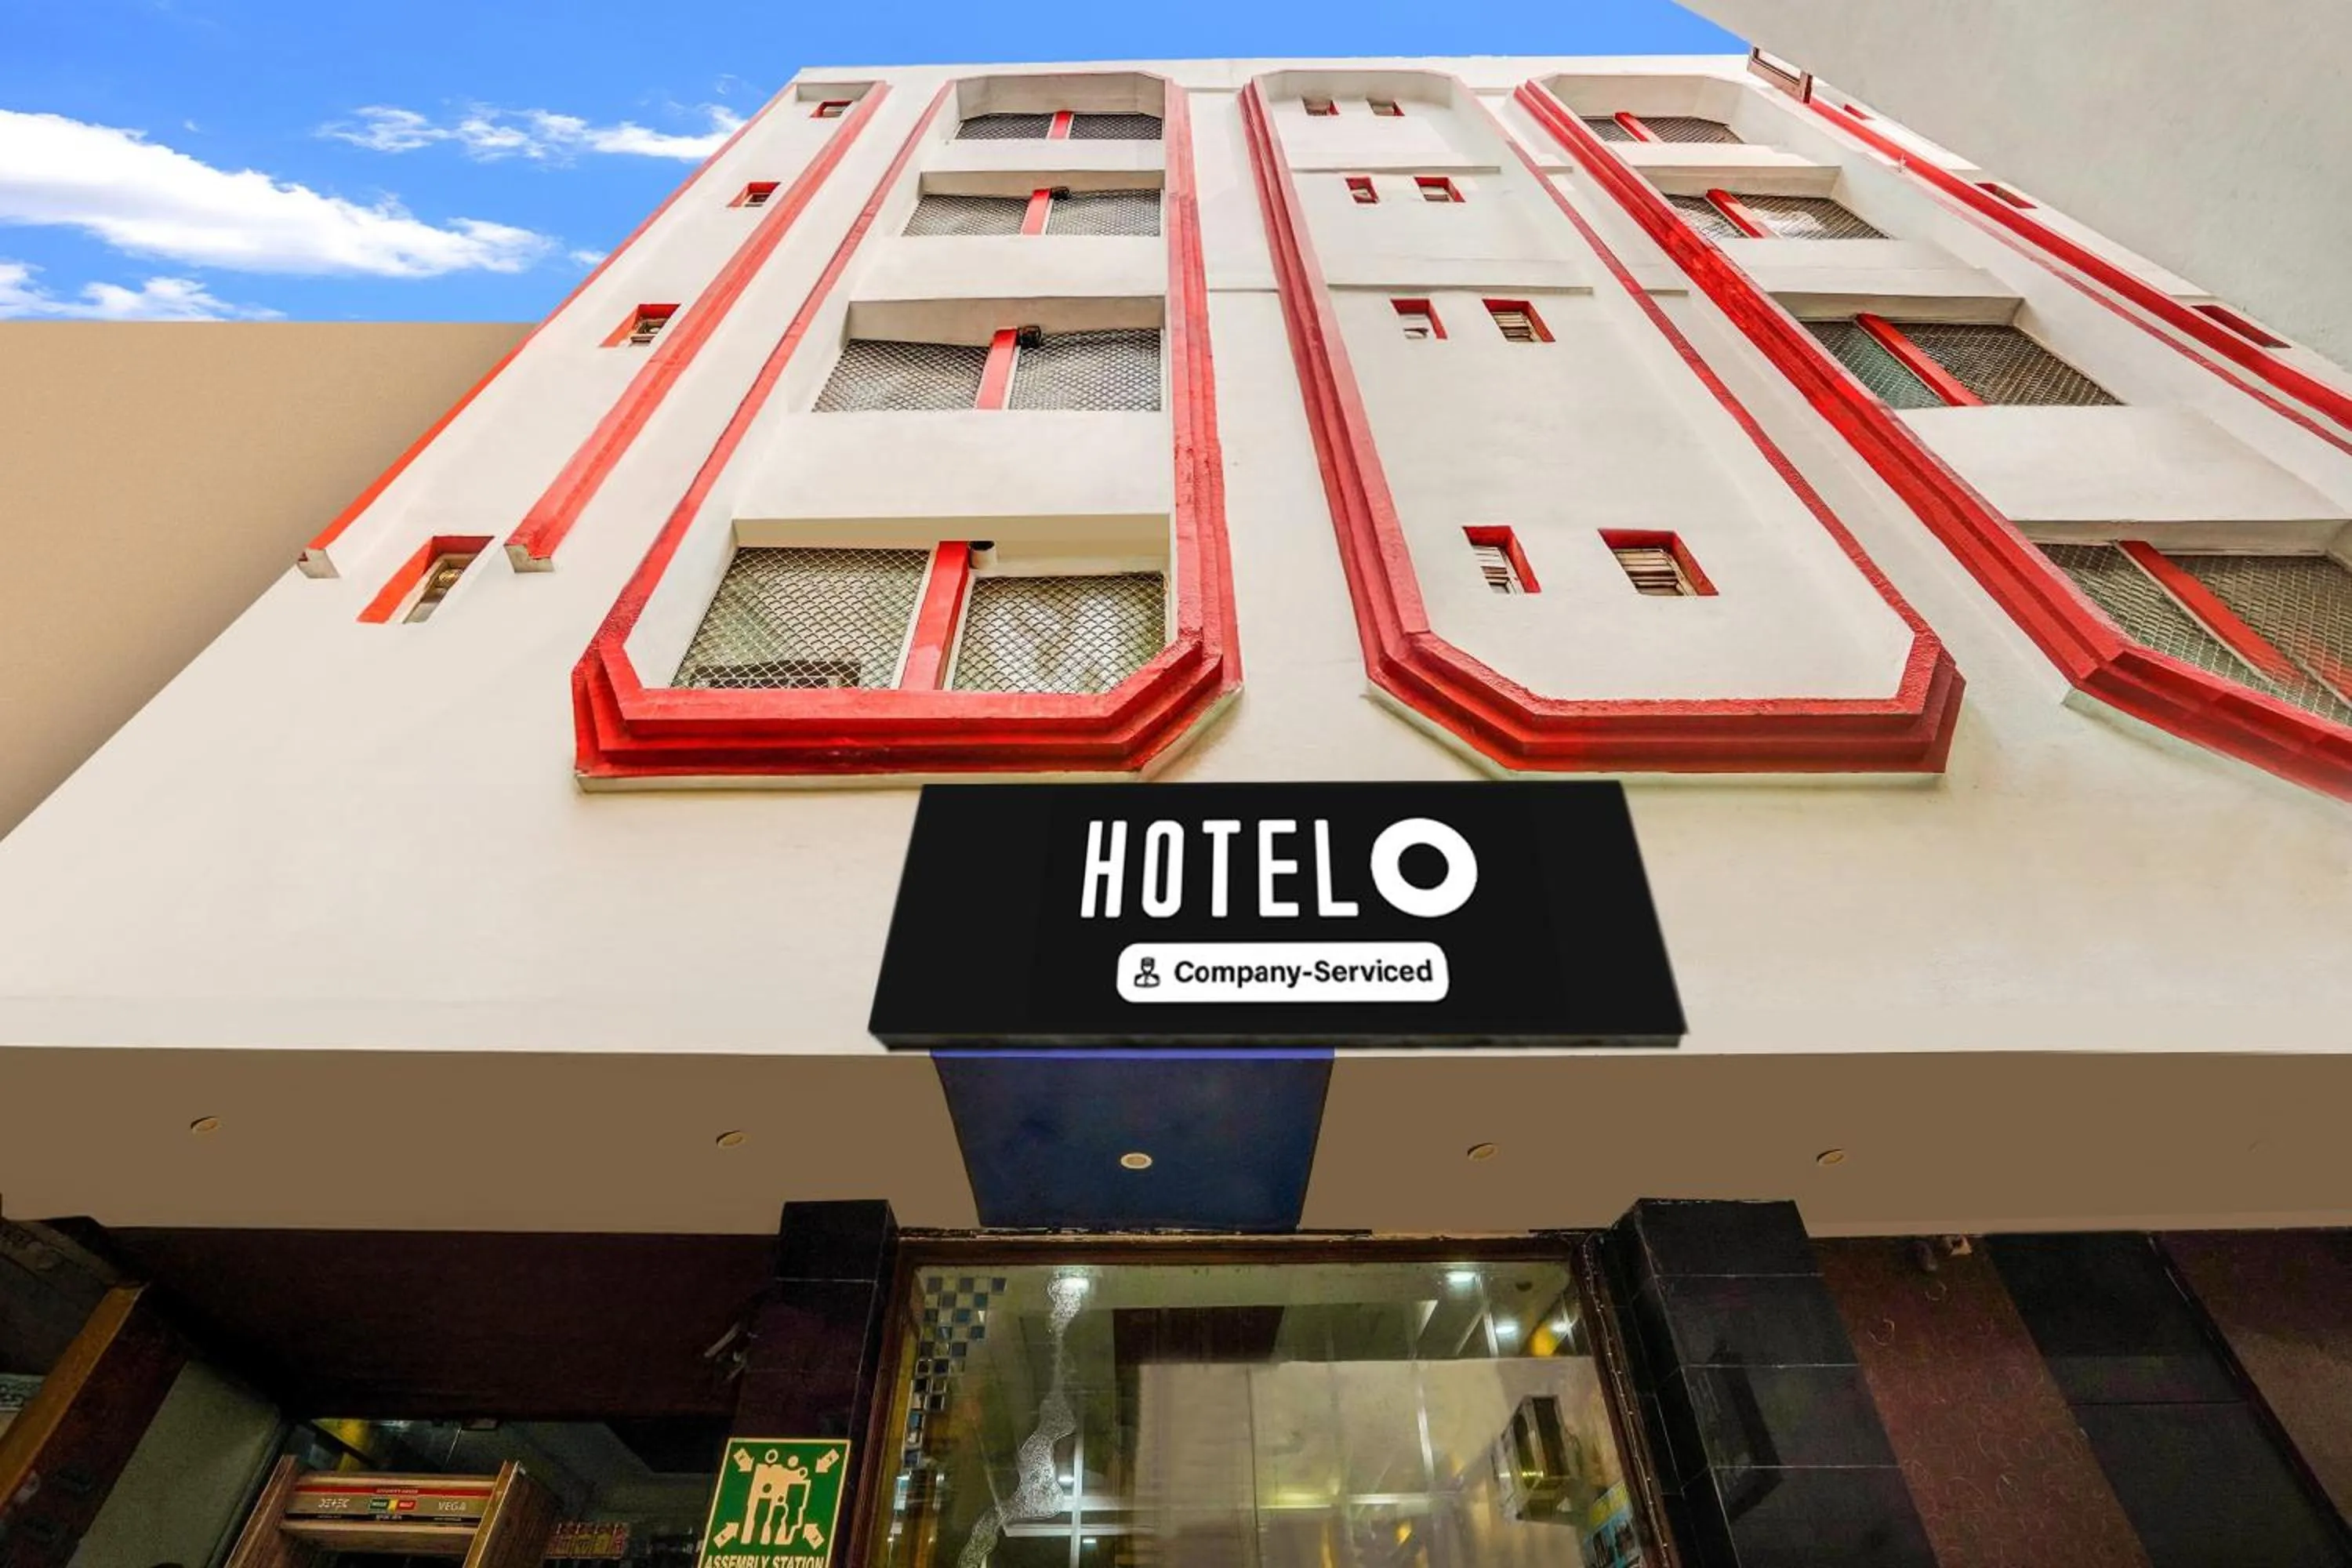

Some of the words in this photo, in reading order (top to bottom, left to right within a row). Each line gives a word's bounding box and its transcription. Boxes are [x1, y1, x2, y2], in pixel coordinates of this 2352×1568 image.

[1080, 818, 1359, 918] HOTEL
[1174, 959, 1434, 989] Company-Serviced
[438, 1501, 466, 1511] VEGA
[704, 1555, 770, 1568] ASSEMBLY
[772, 1555, 825, 1568] STATION
